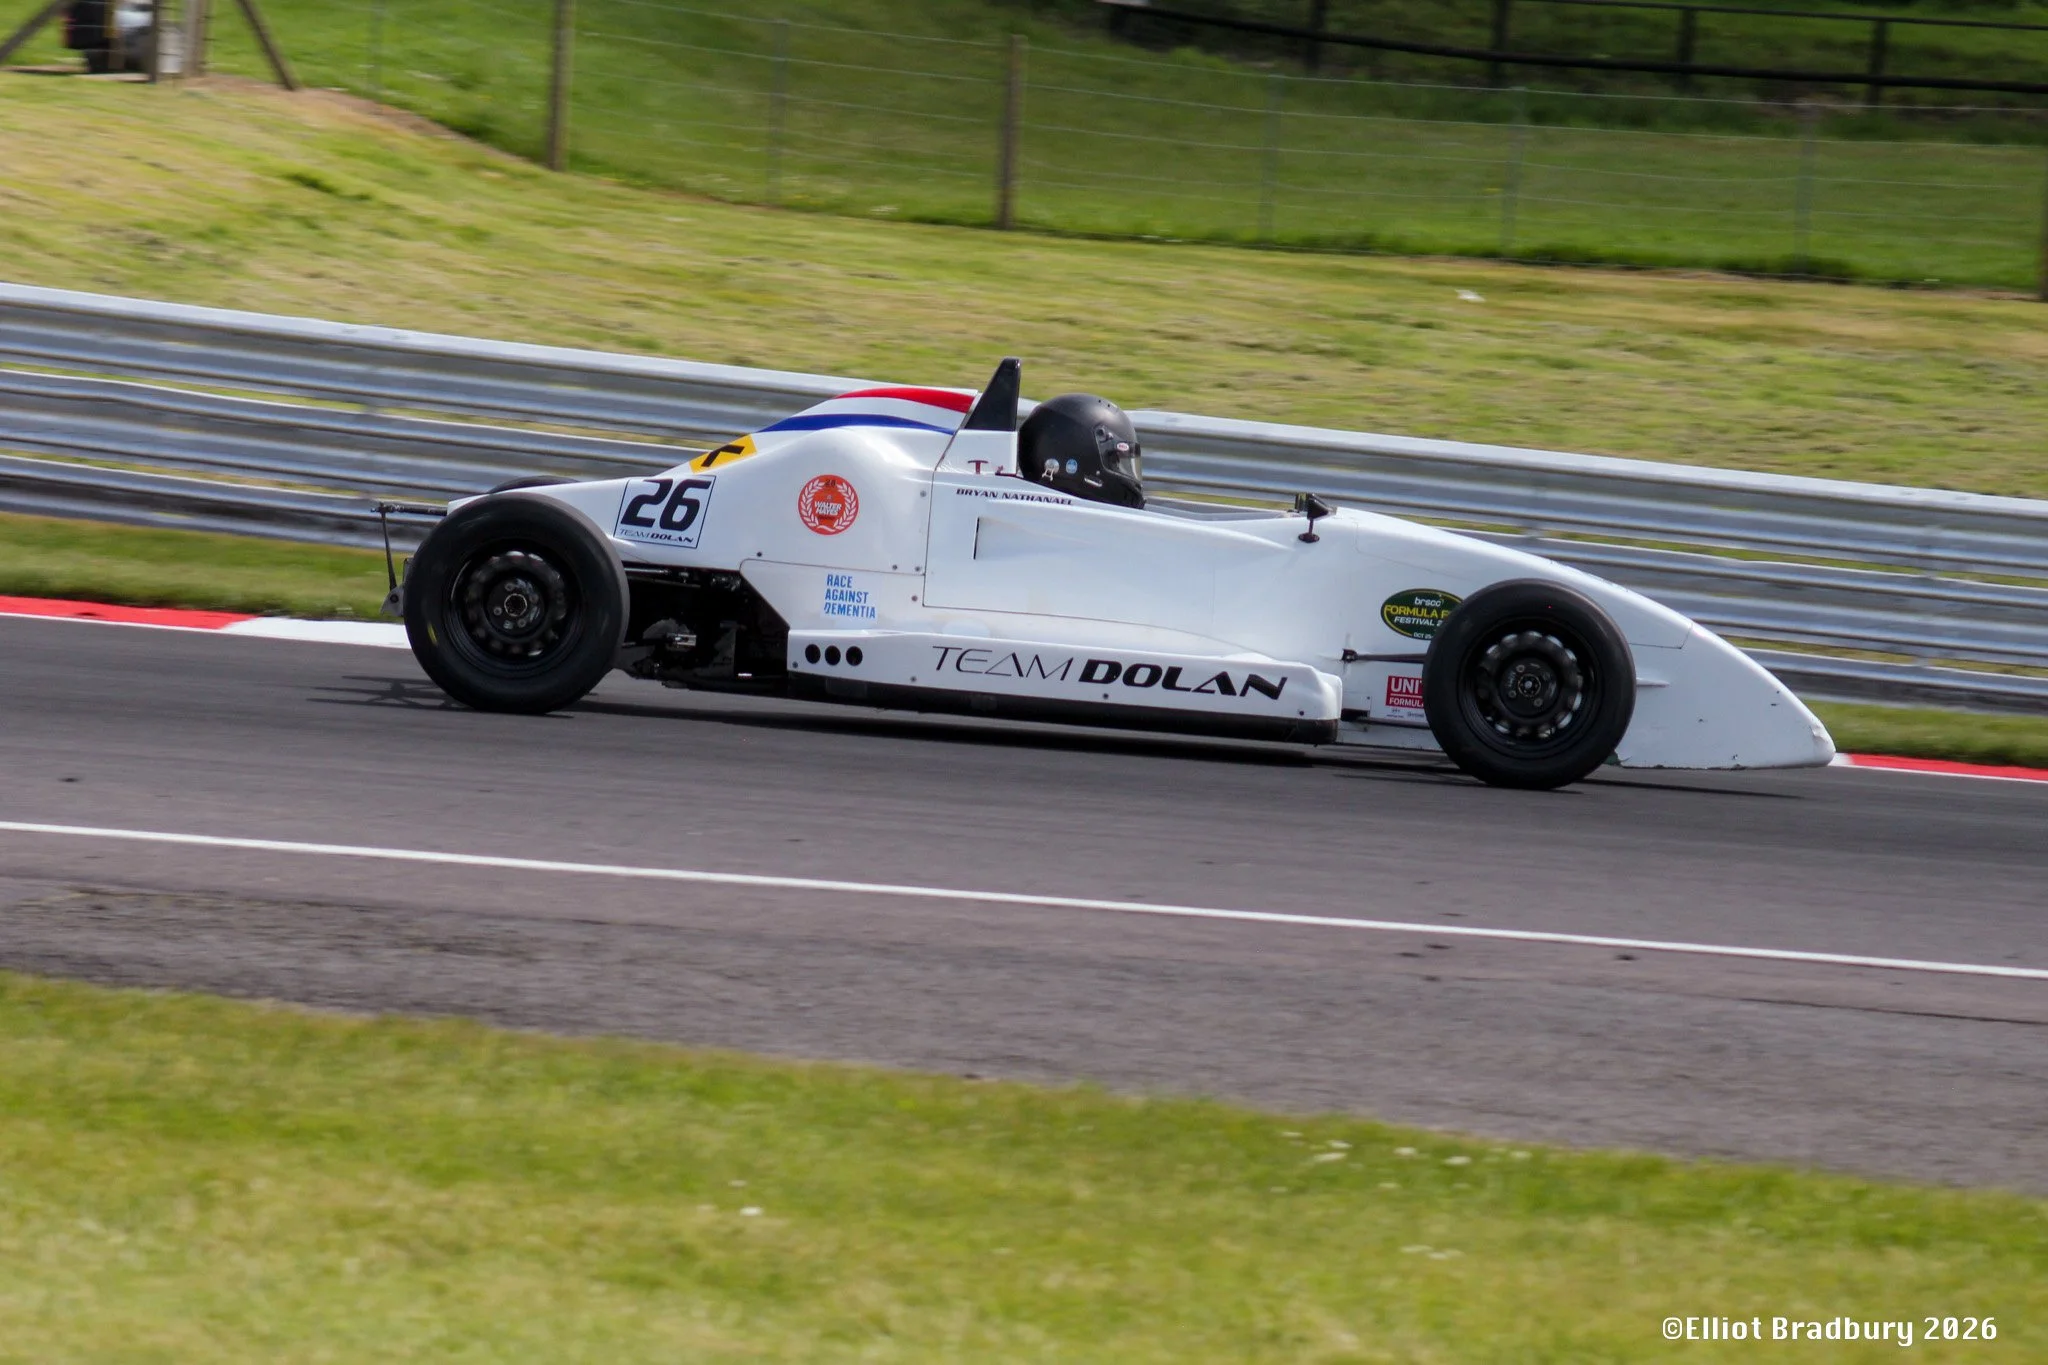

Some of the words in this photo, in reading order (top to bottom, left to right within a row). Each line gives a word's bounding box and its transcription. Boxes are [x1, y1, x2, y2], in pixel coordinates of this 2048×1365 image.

[956, 488, 998, 499] BRYAN
[1001, 492, 1073, 506] NATHANAEL
[620, 478, 712, 532] 26
[620, 529, 651, 538] TEAM
[650, 532, 694, 543] DOLAN
[827, 574, 853, 588] RACE
[825, 588, 869, 604] AGAINST
[1414, 596, 1441, 607] brscc
[824, 602, 876, 618] DEMENTIA
[1385, 604, 1438, 618] FORMULA
[1394, 616, 1435, 627] FESTIVAL
[932, 646, 1074, 681] TEAM
[1078, 658, 1288, 700] DOLAN
[1390, 678, 1422, 694] UNI
[1389, 697, 1424, 707] FORMUL
